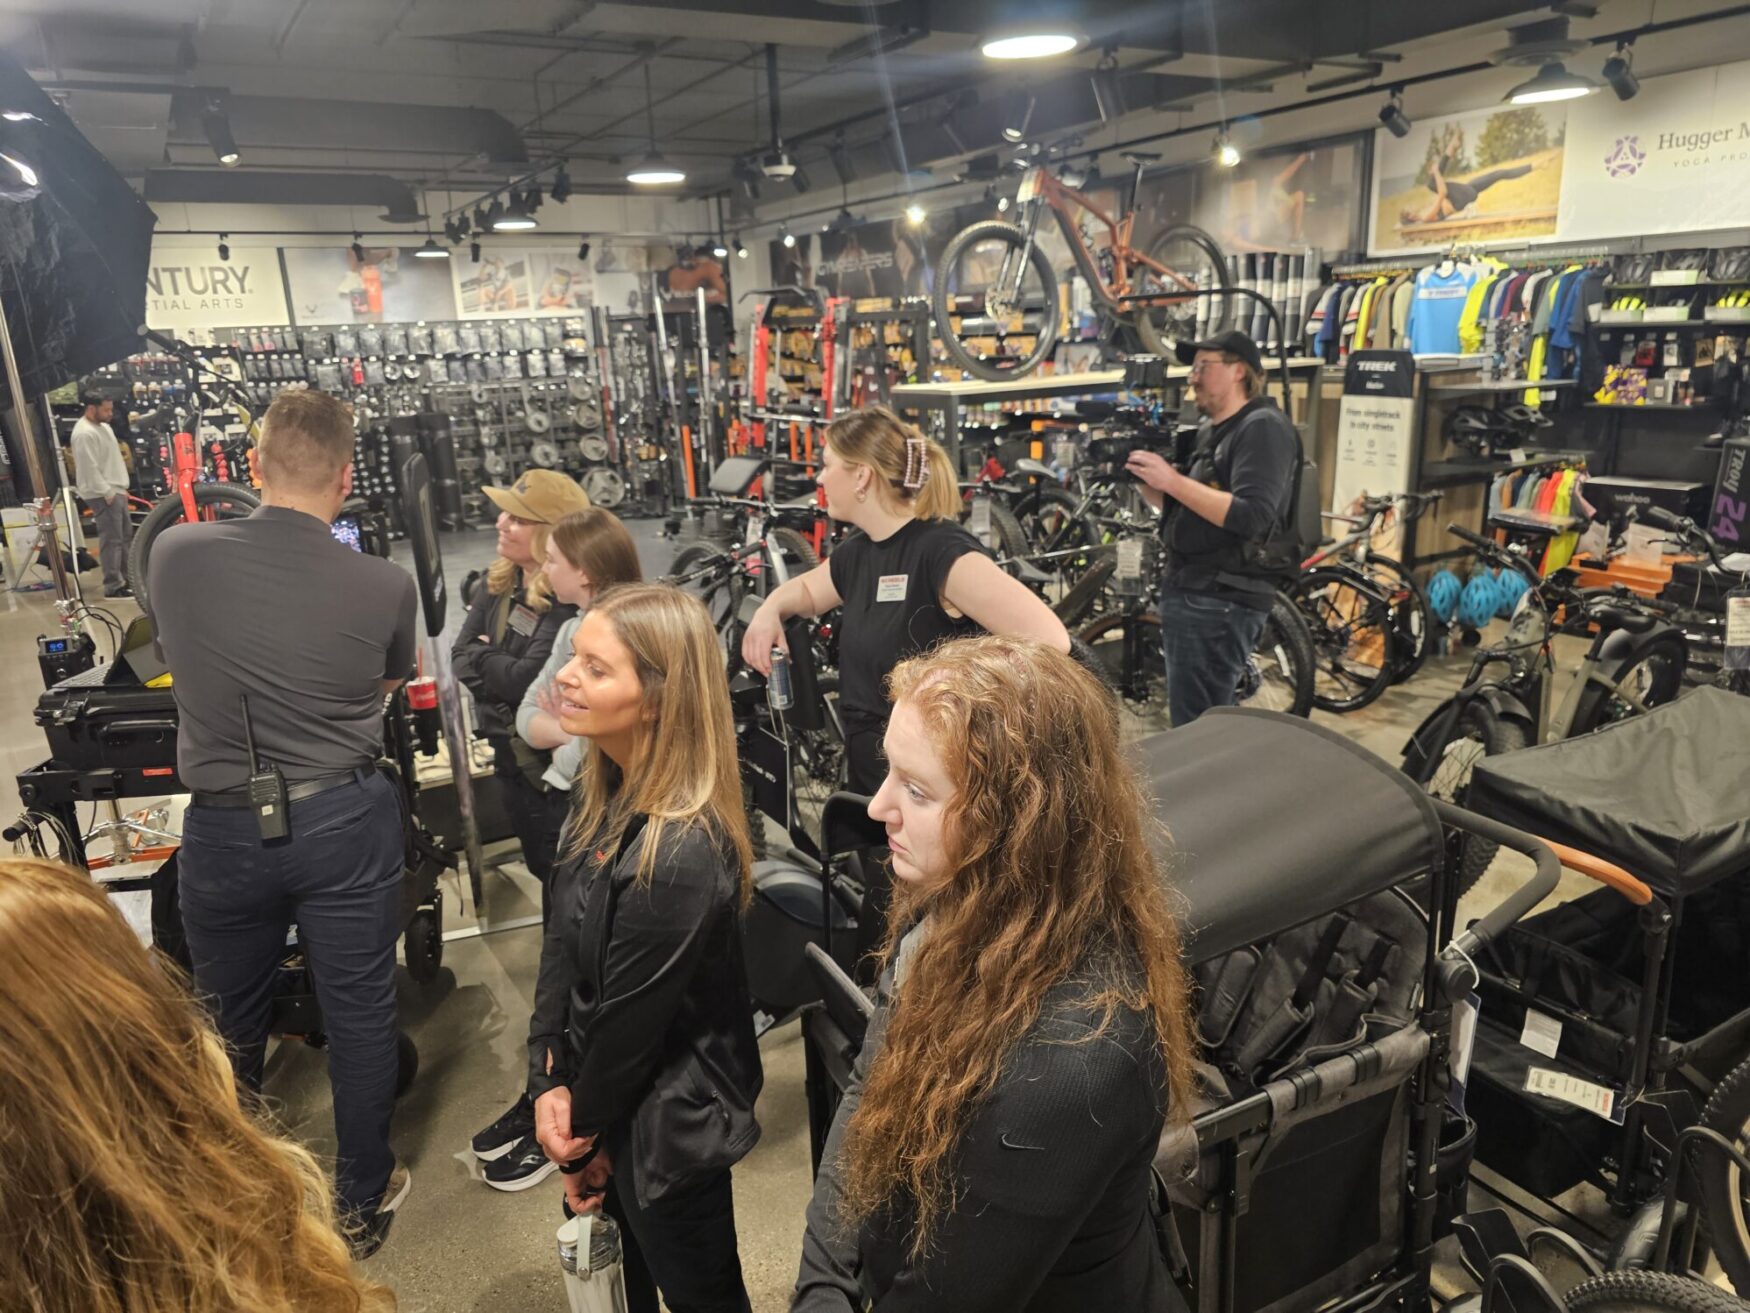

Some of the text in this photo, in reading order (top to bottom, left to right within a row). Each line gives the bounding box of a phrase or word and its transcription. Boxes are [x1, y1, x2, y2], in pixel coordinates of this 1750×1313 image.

[1658, 128, 1733, 151] Hugger
[1673, 157, 1711, 168] YOGA
[200, 298, 243, 309] ARTS
[1357, 361, 1397, 371] TREK
[1712, 494, 1747, 541] 24
